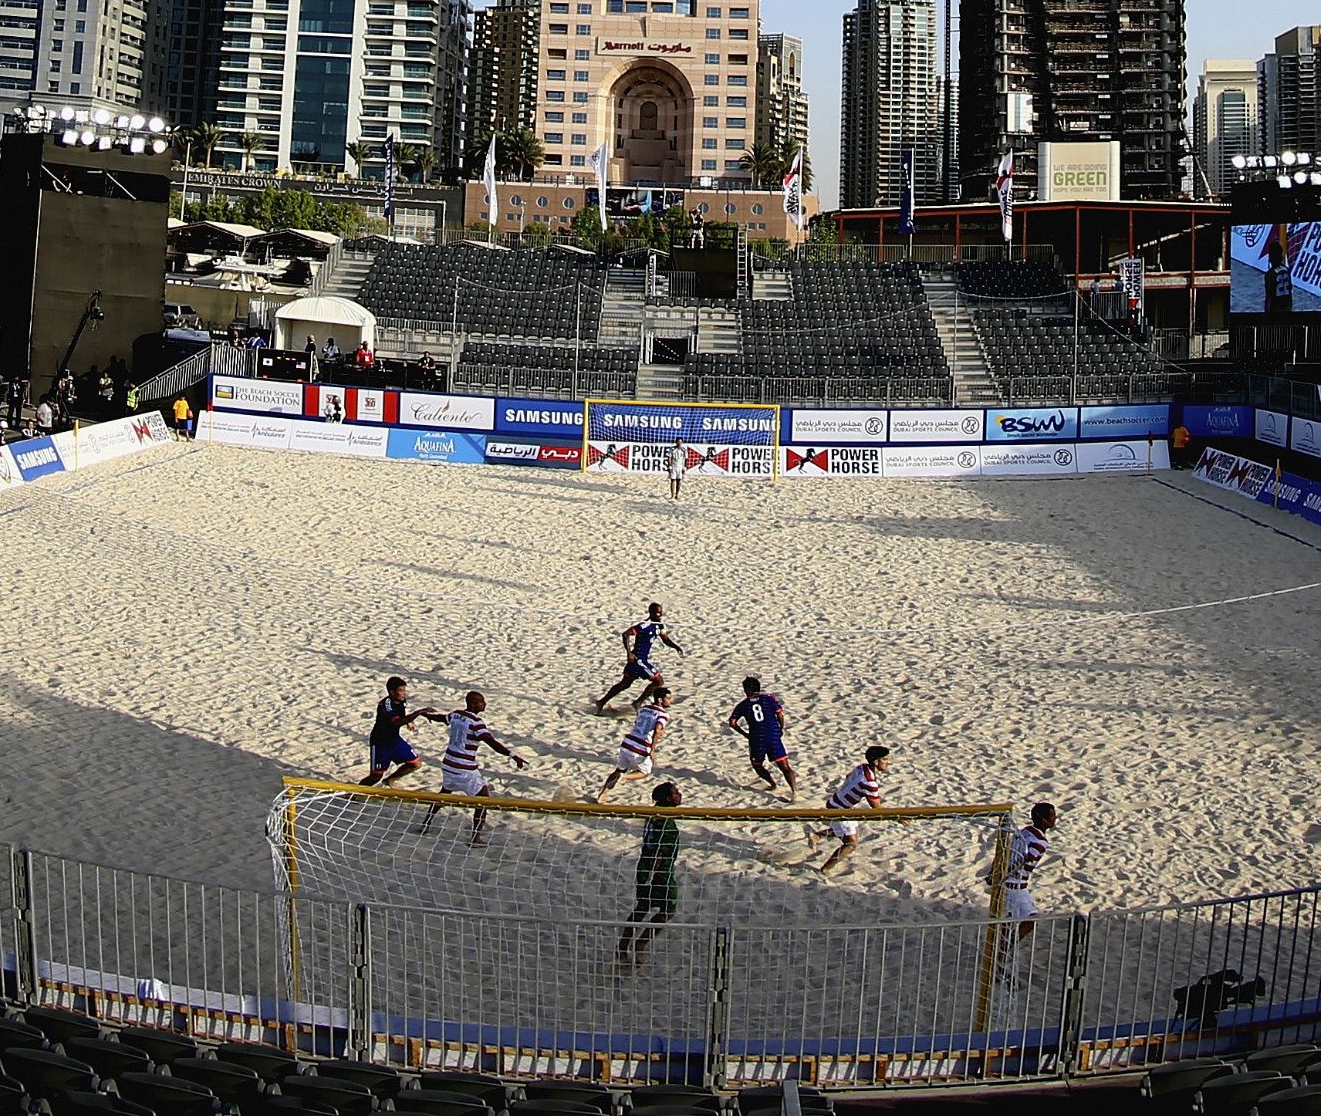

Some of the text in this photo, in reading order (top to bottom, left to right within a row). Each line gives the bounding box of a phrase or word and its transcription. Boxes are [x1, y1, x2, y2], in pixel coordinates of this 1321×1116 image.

[1053, 163, 1065, 171] WE
[1067, 163, 1082, 171] ARE
[187, 173, 282, 188] EMIRATES CROWN
[1053, 172, 1107, 186] GREEN
[235, 386, 300, 398] THE BEACH SOCCER
[235, 392, 300, 407] FOUNDATION
[410, 401, 482, 423] Caliente
[505, 409, 584, 425] SAMSUNG
[604, 414, 682, 429] SAMSUNG
[1083, 416, 1166, 426] www.beachsoccer.com
[414, 436, 455, 454] AQUAFINA
[489, 443, 536, 458] الرياضية
[16, 446, 58, 470] SAMSUNG
[542, 449, 579, 459] دبي
[831, 449, 878, 461] POWER
[632, 459, 669, 471] HORS
[831, 462, 879, 474] HORSE
[751, 704, 765, 723] 8
